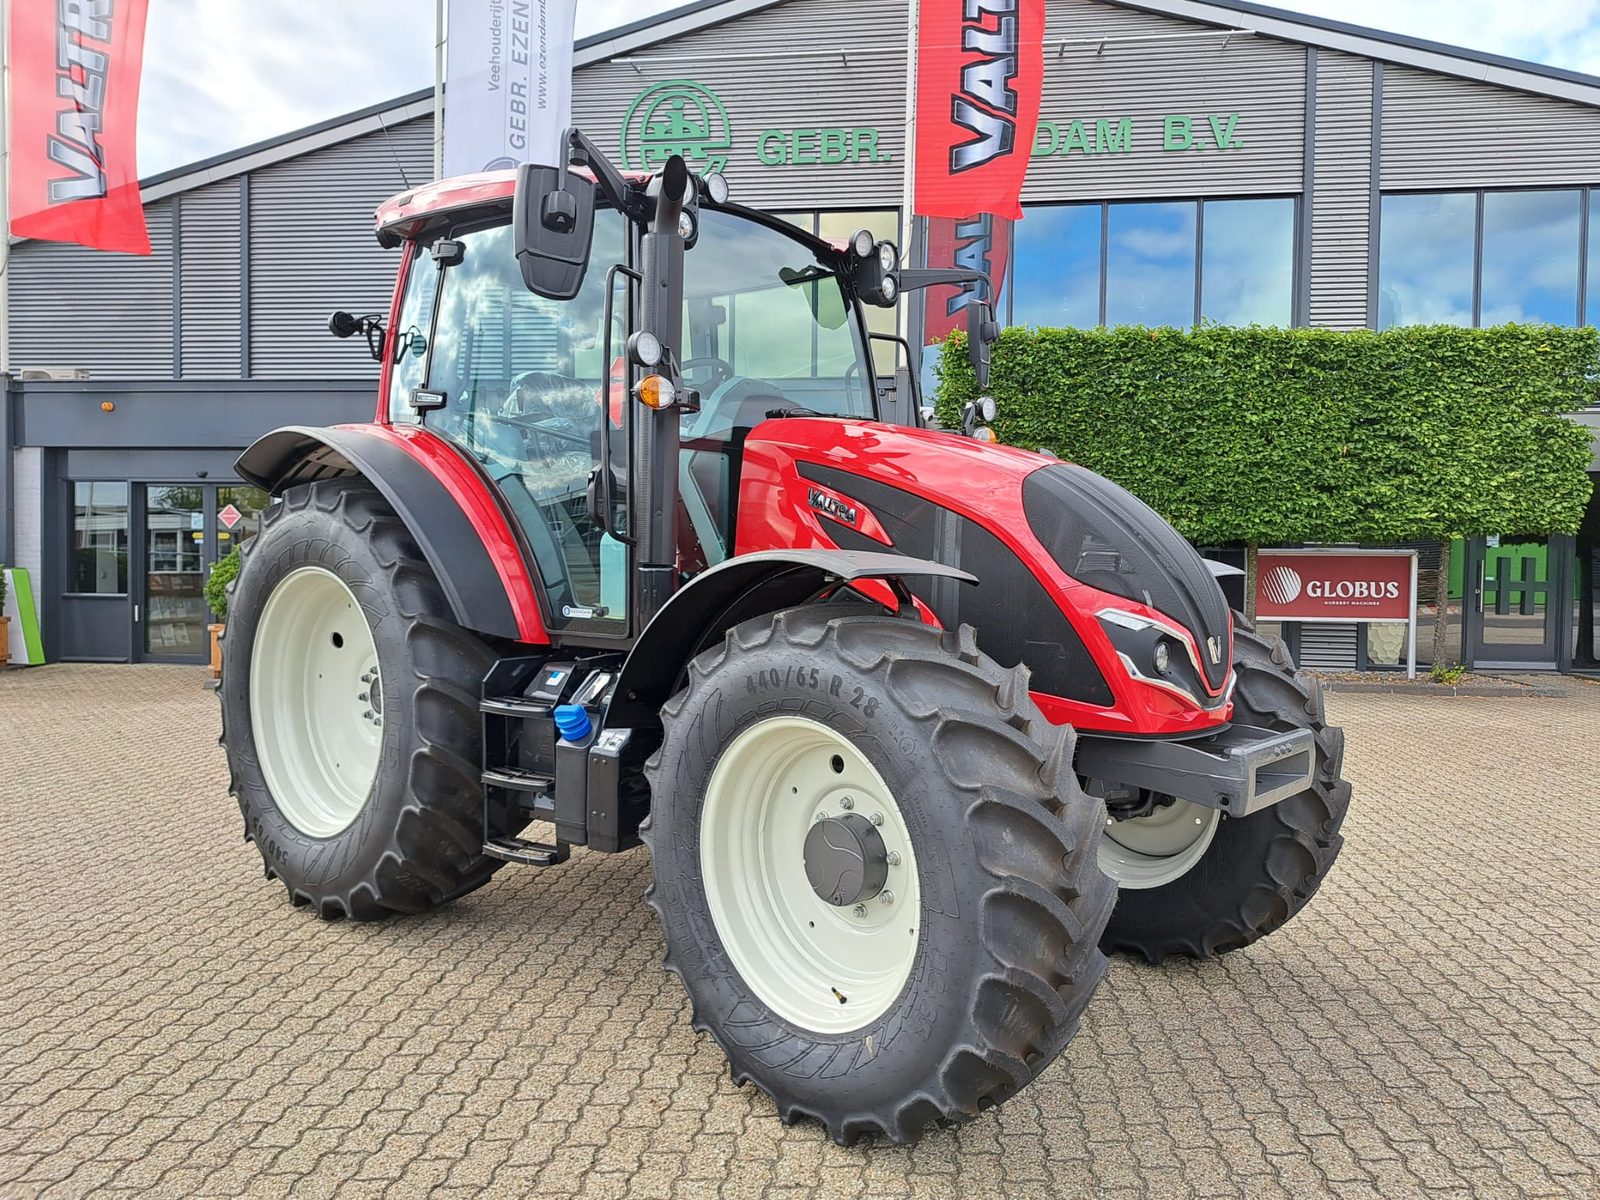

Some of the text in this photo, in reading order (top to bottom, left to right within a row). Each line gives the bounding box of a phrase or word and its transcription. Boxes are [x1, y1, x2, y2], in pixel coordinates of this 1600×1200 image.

[509, 76, 528, 150] GEBR.
[756, 128, 892, 166] GEBR.
[1163, 112, 1244, 151] B.V.
[808, 487, 857, 526] VALTRA
[1306, 580, 1400, 599] GLOBUS
[746, 665, 880, 719] 440/65 R 28
